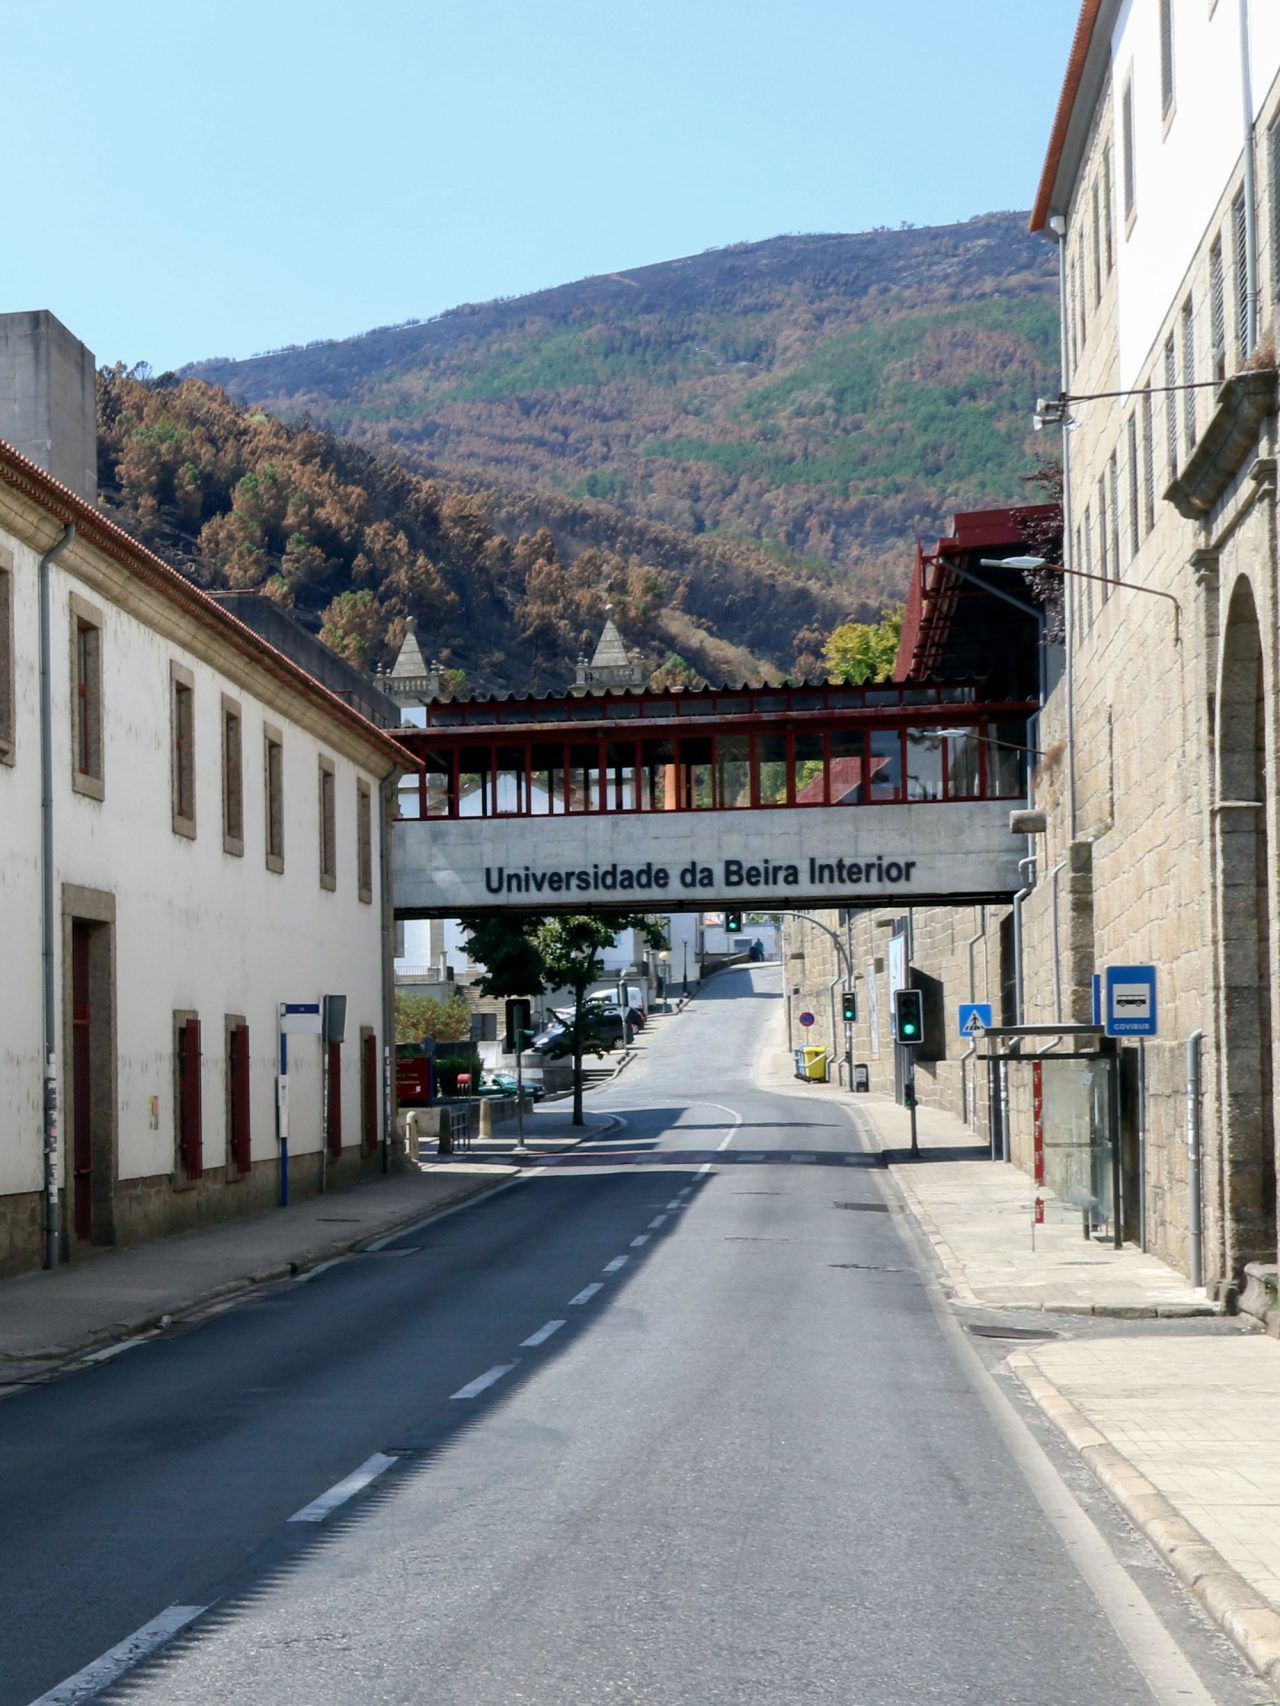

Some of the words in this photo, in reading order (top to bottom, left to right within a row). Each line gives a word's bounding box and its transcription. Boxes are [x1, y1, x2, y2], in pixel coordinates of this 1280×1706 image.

[484, 861, 671, 895] Universidade
[679, 860, 715, 889] da
[723, 857, 800, 888] Beira
[808, 854, 918, 885] Interior
[1113, 1023, 1150, 1031] COVIBUS
